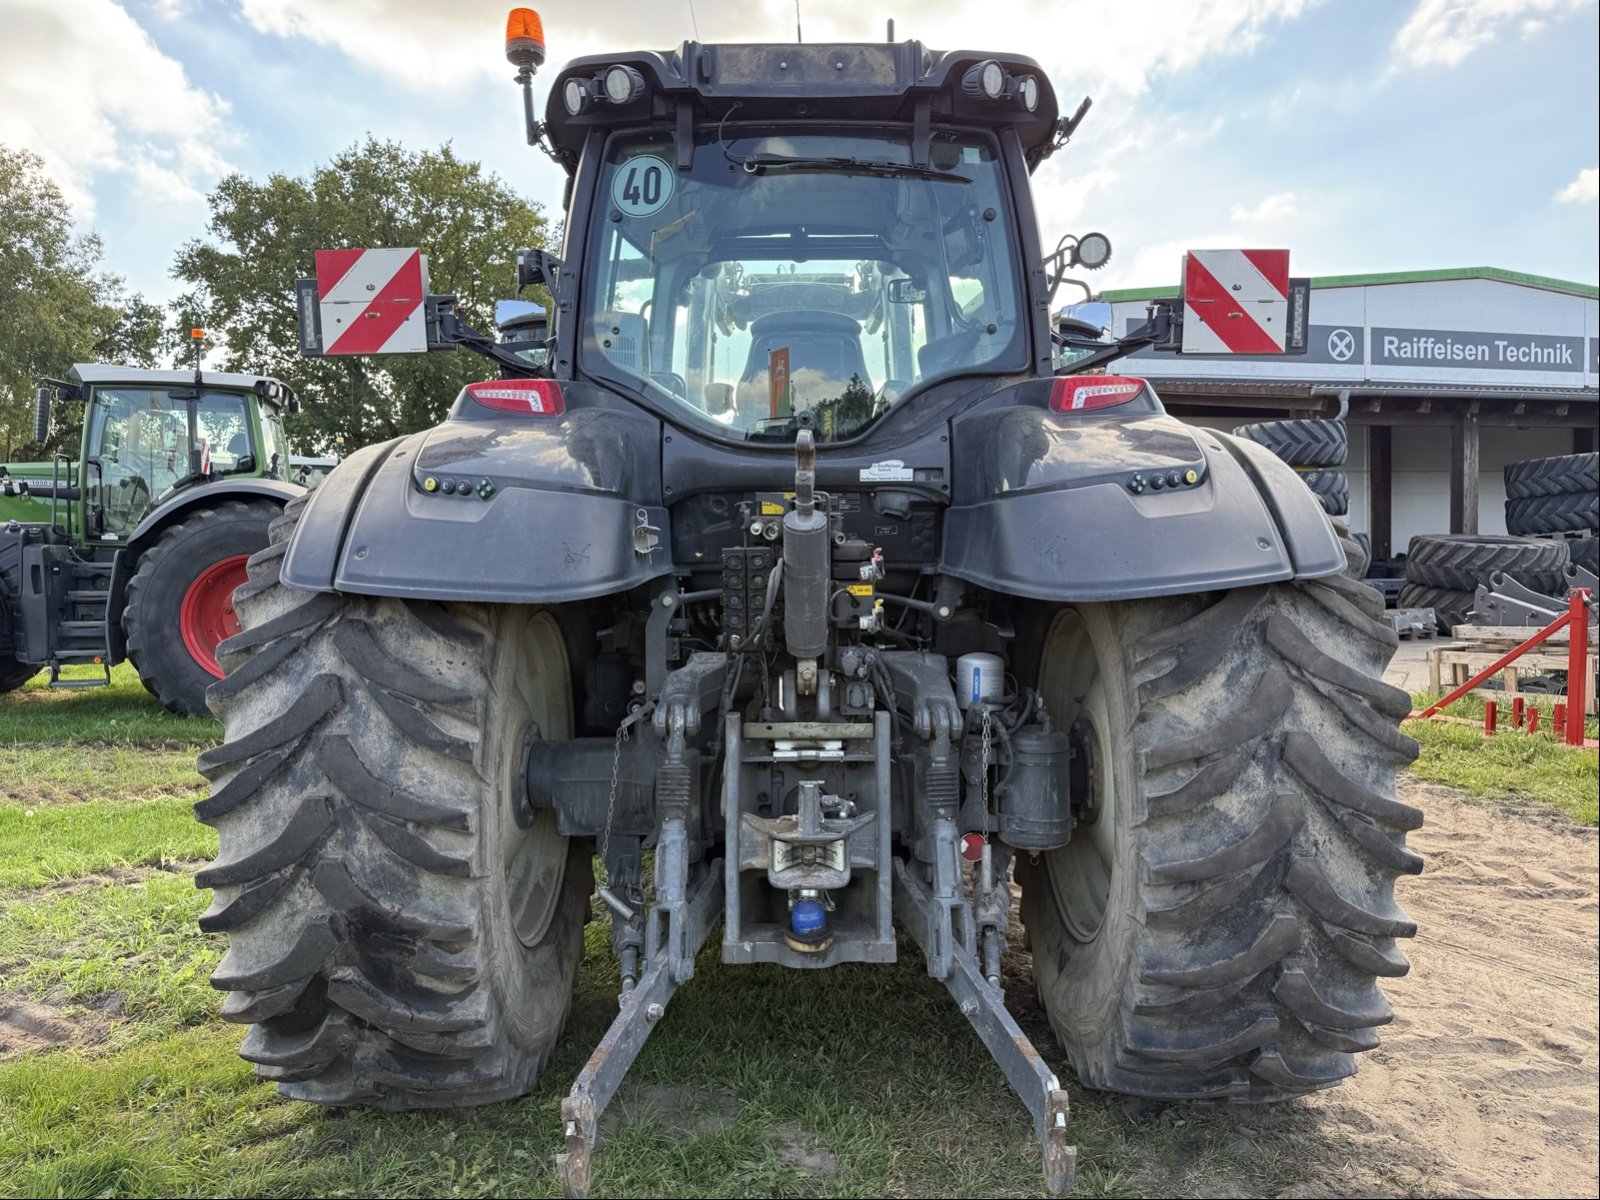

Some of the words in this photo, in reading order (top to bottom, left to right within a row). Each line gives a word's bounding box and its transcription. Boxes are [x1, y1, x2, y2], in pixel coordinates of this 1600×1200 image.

[623, 166, 661, 205] 40
[1383, 335, 1489, 361] Raiffeisen
[1494, 340, 1573, 364] Technik
